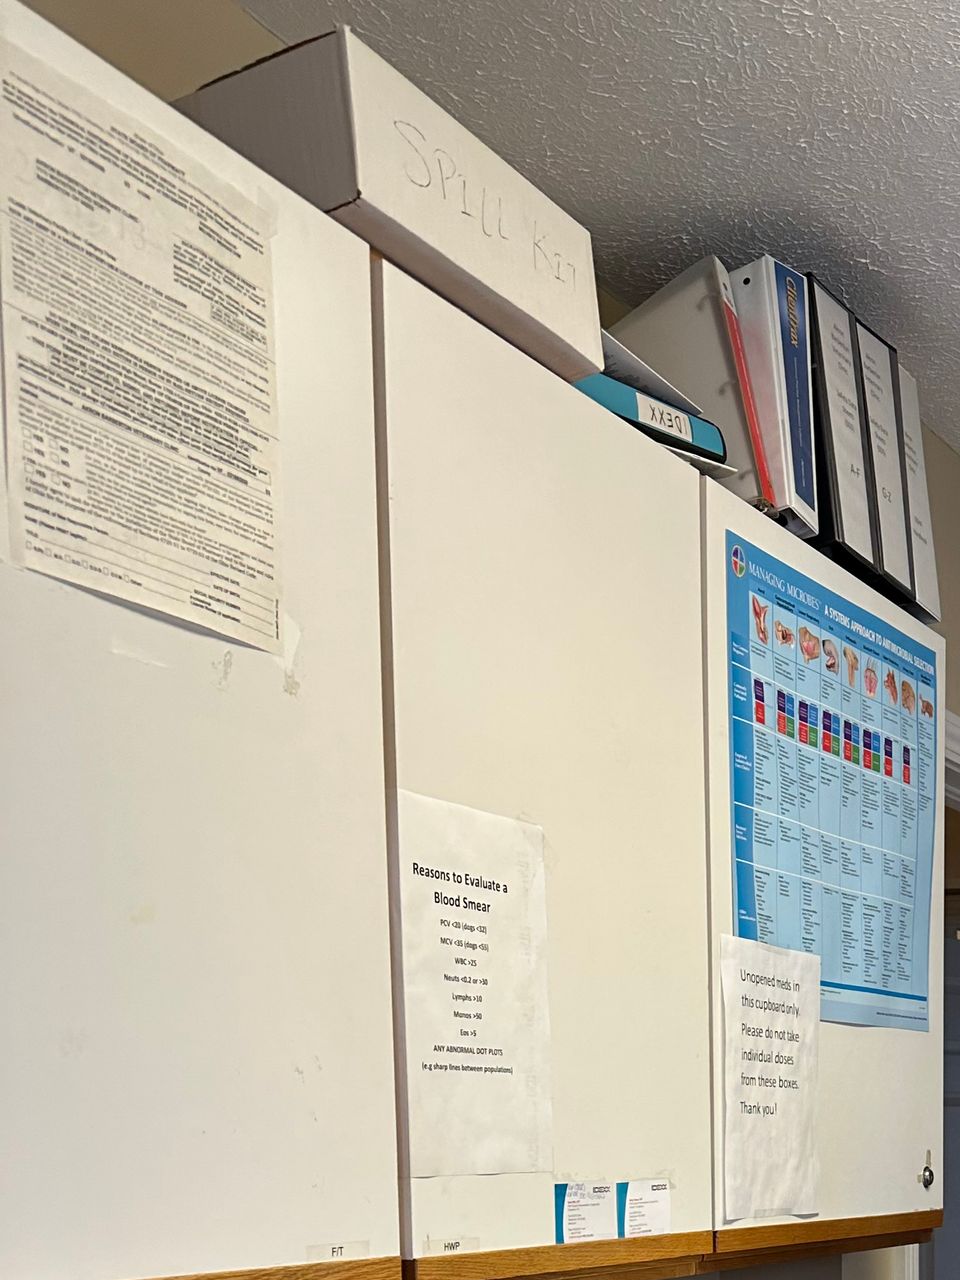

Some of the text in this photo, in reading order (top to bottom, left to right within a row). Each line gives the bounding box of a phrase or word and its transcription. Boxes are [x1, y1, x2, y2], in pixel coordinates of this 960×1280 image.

[749, 561, 785, 592] MANAGING
[787, 581, 820, 611] MICROBES
[824, 604, 829, 617] A
[412, 862, 508, 894] Reasons to Evaluate a
[434, 891, 491, 913] Blood Smear
[440, 919, 451, 928] PCV
[440, 937, 453, 946] MCV
[454, 957, 467, 966] WBC
[443, 973, 460, 983] Neuts
[740, 969, 800, 992] Unopened meds in
[452, 993, 472, 1002] Lymphs
[741, 994, 801, 1019] this cupboard only.
[741, 1022, 800, 1043] Please do not take
[433, 1045, 503, 1056] ANY ABNORMAL DOT PLOTS
[741, 1048, 794, 1065] individual doses
[740, 1072, 800, 1090] from these boxes.
[740, 1101, 778, 1118] Thank you!
[443, 1241, 460, 1252] HWP
